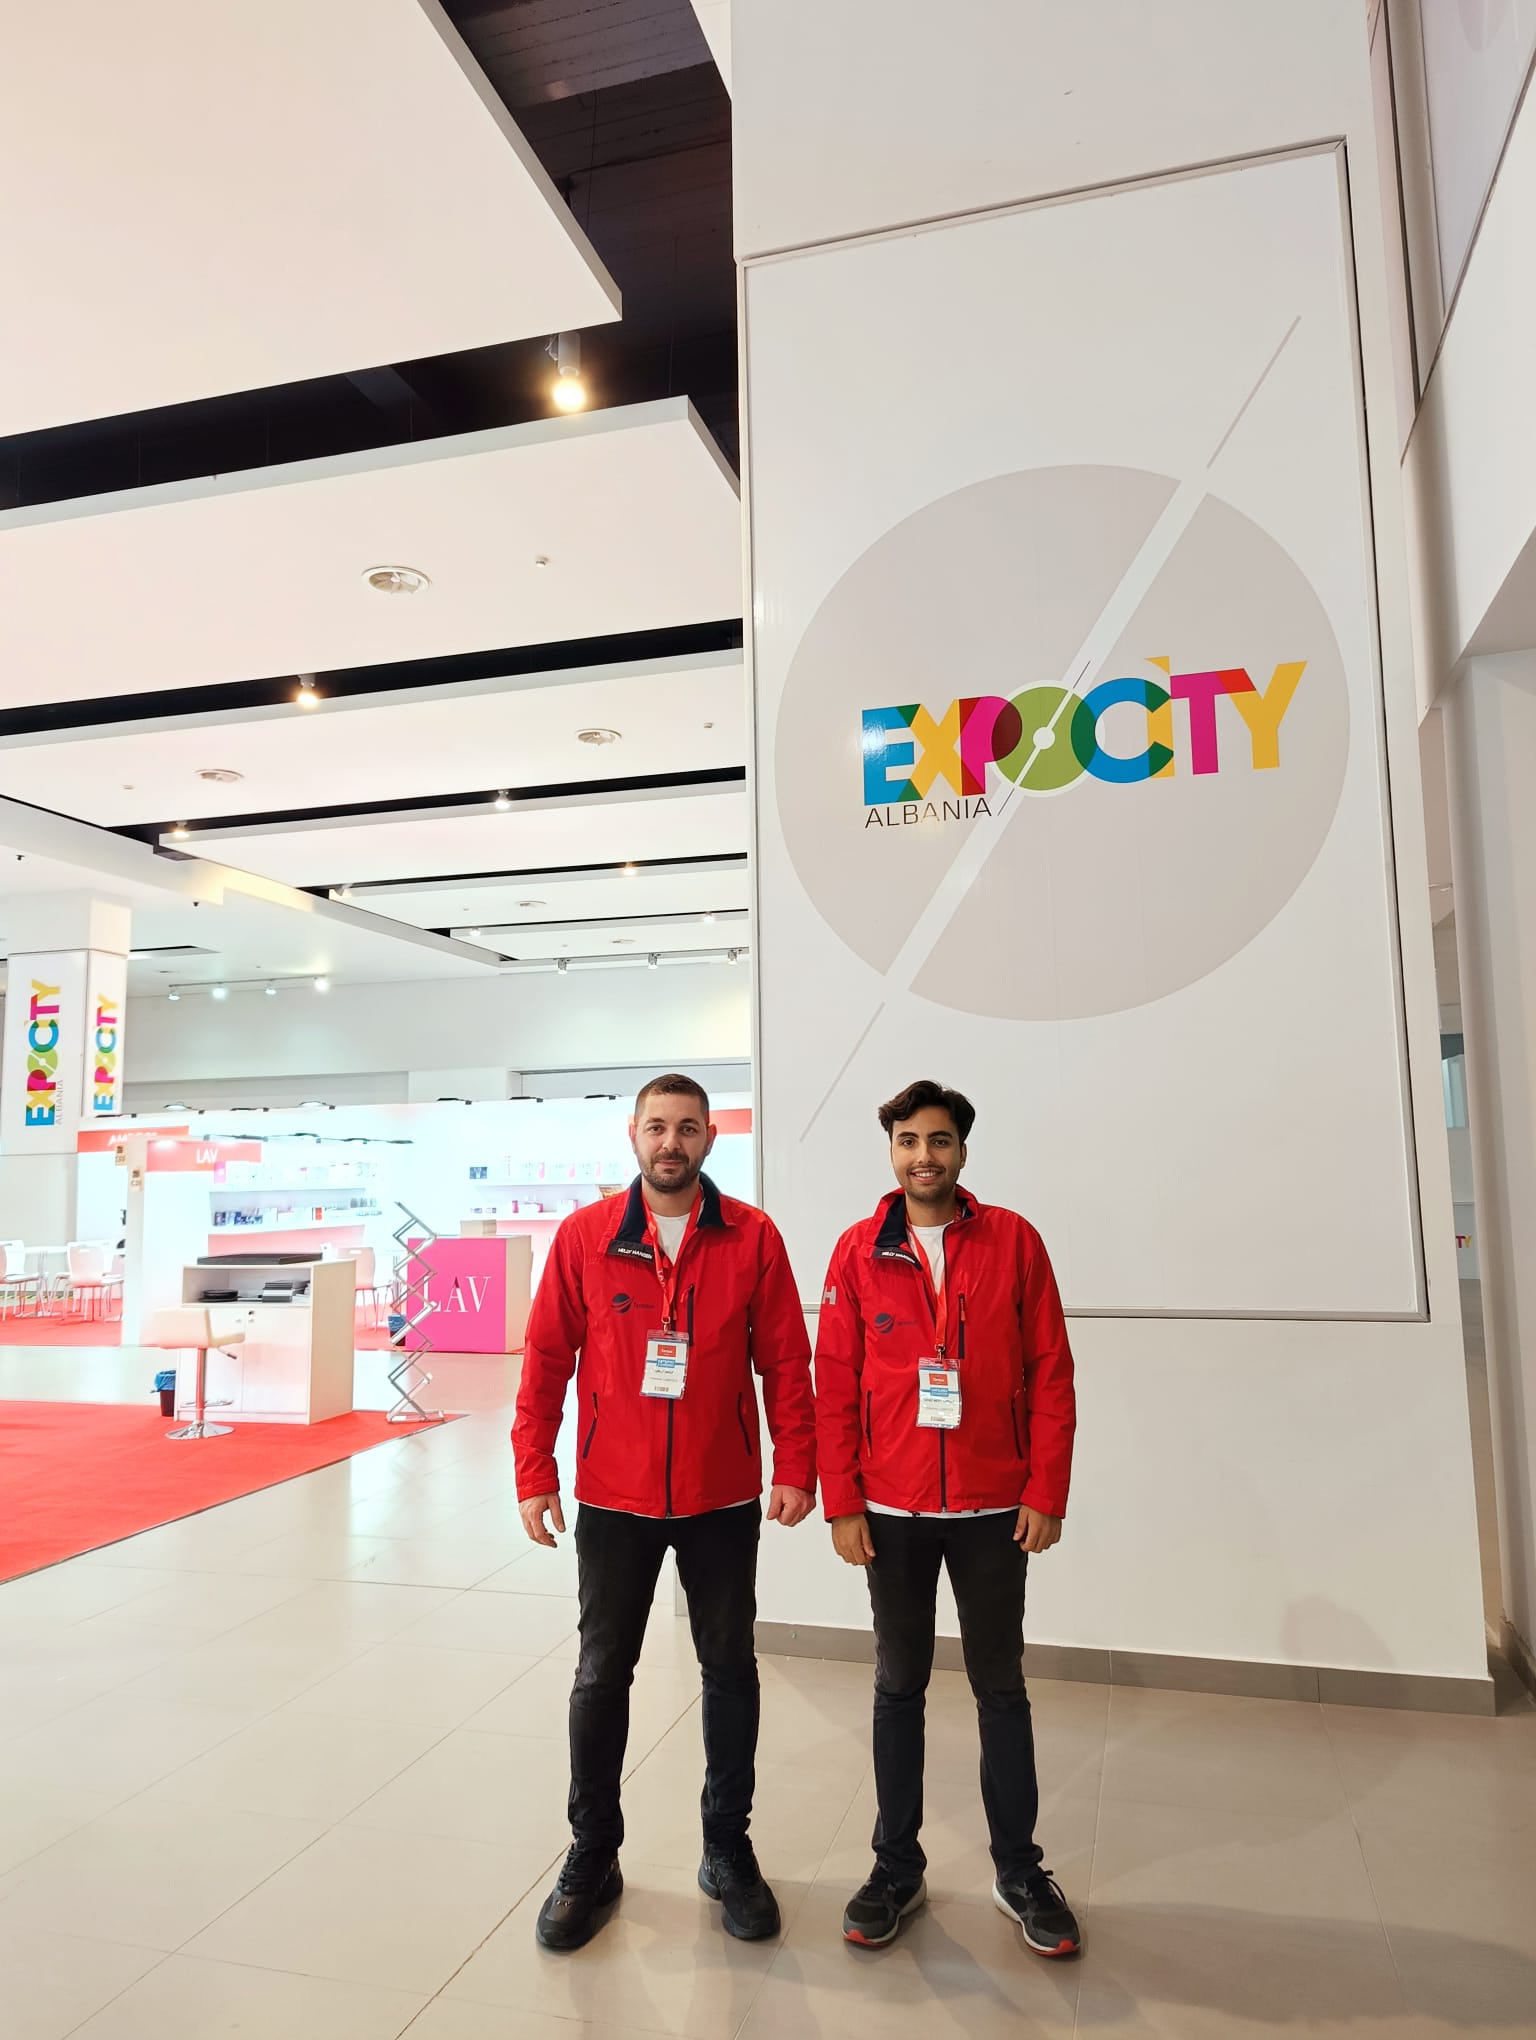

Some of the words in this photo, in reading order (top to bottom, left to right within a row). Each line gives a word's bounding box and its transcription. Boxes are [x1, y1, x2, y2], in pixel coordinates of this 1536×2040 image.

[864, 797, 993, 829] ALBANIA
[196, 1148, 218, 1164] LAV
[422, 1276, 492, 1313] LAV
